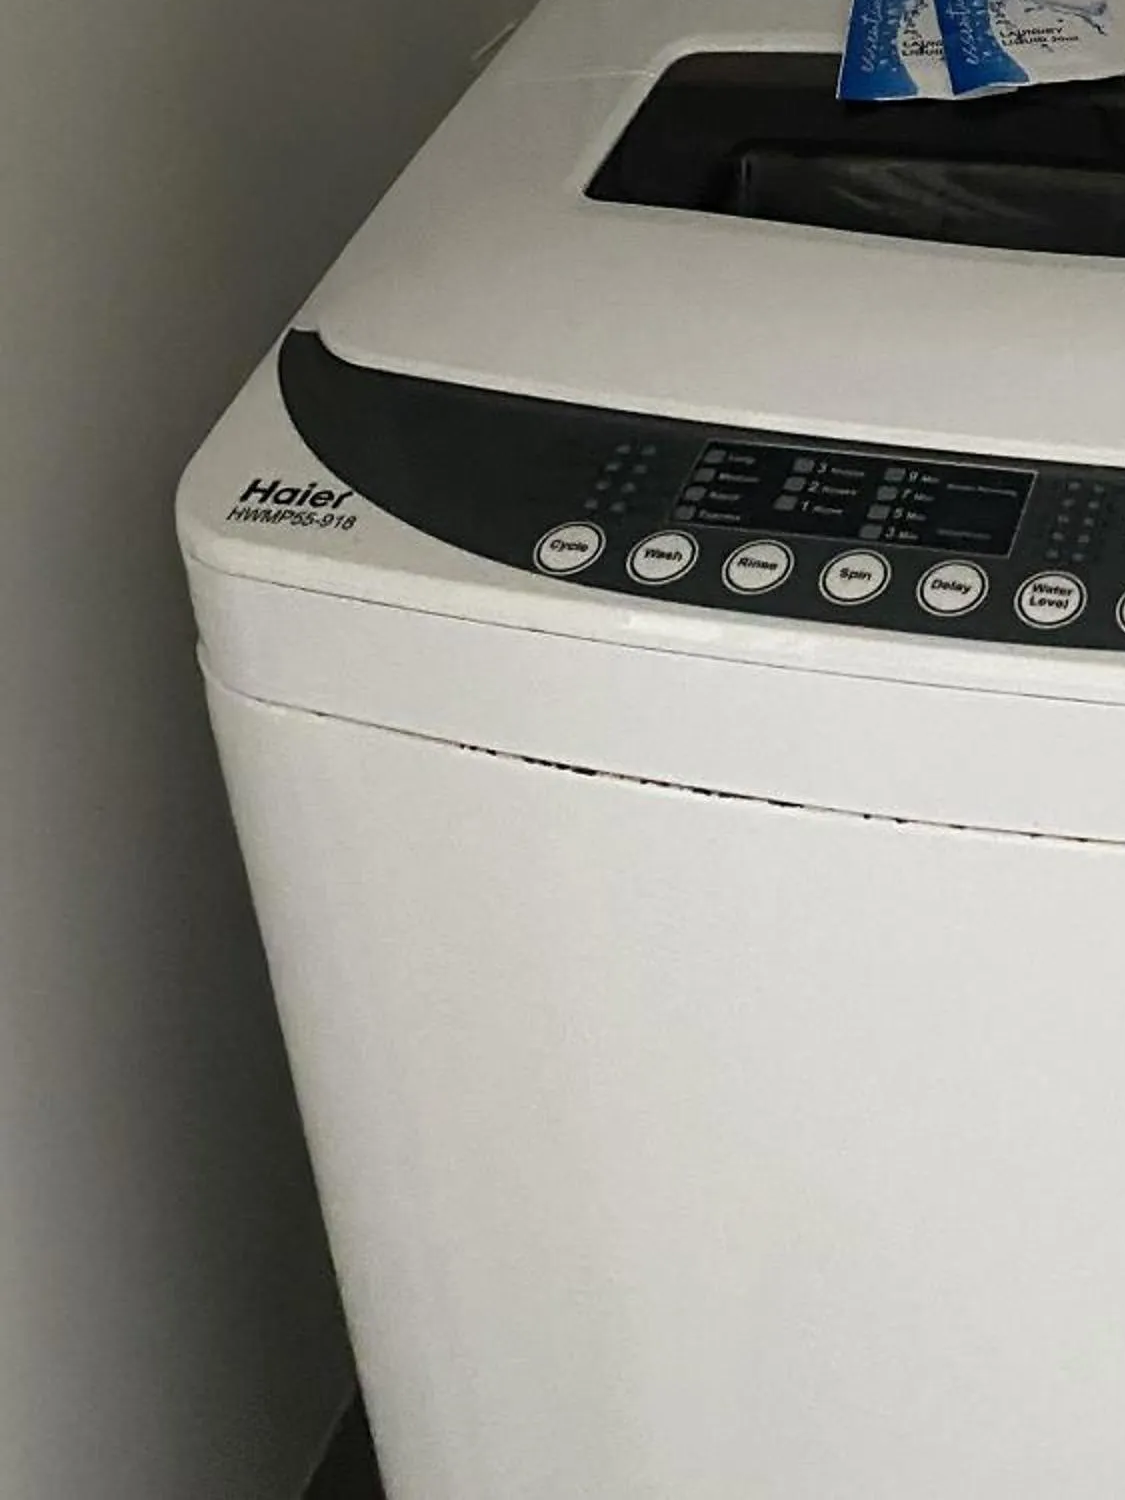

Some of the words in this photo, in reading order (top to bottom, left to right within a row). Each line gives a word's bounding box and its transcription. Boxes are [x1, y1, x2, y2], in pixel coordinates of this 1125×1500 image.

[239, 478, 354, 509] Haier
[226, 507, 358, 532] HWMP55-918
[550, 539, 589, 553] Cycle
[643, 548, 683, 562] Wash
[737, 556, 779, 571] Rinse
[839, 567, 873, 581] Spin
[930, 579, 973, 595] Delay
[1032, 583, 1074, 597] Water
[1029, 596, 1070, 610] Level
